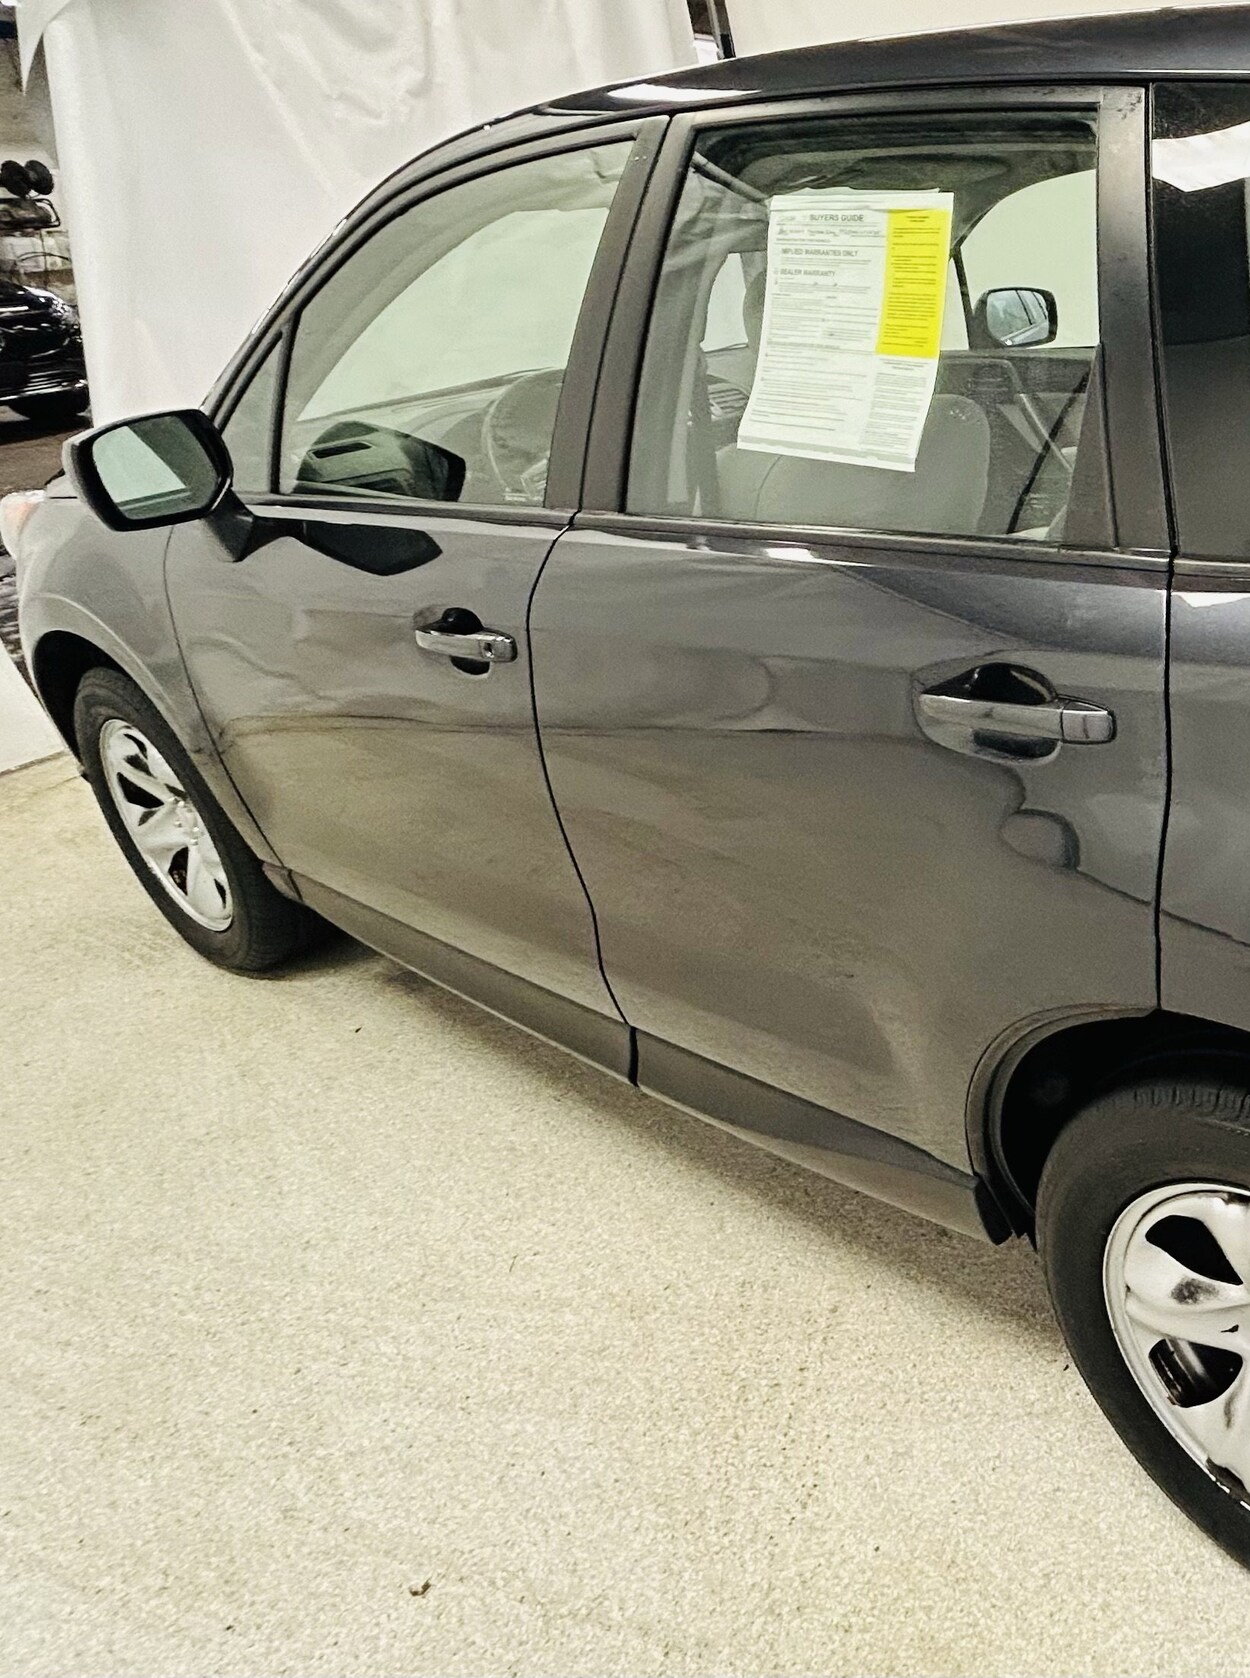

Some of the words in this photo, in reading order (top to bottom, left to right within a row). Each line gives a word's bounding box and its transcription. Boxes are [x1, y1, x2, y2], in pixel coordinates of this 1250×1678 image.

[809, 214, 839, 222] BUYERS
[841, 214, 864, 222] GUIDE
[780, 268, 802, 276] DEALER
